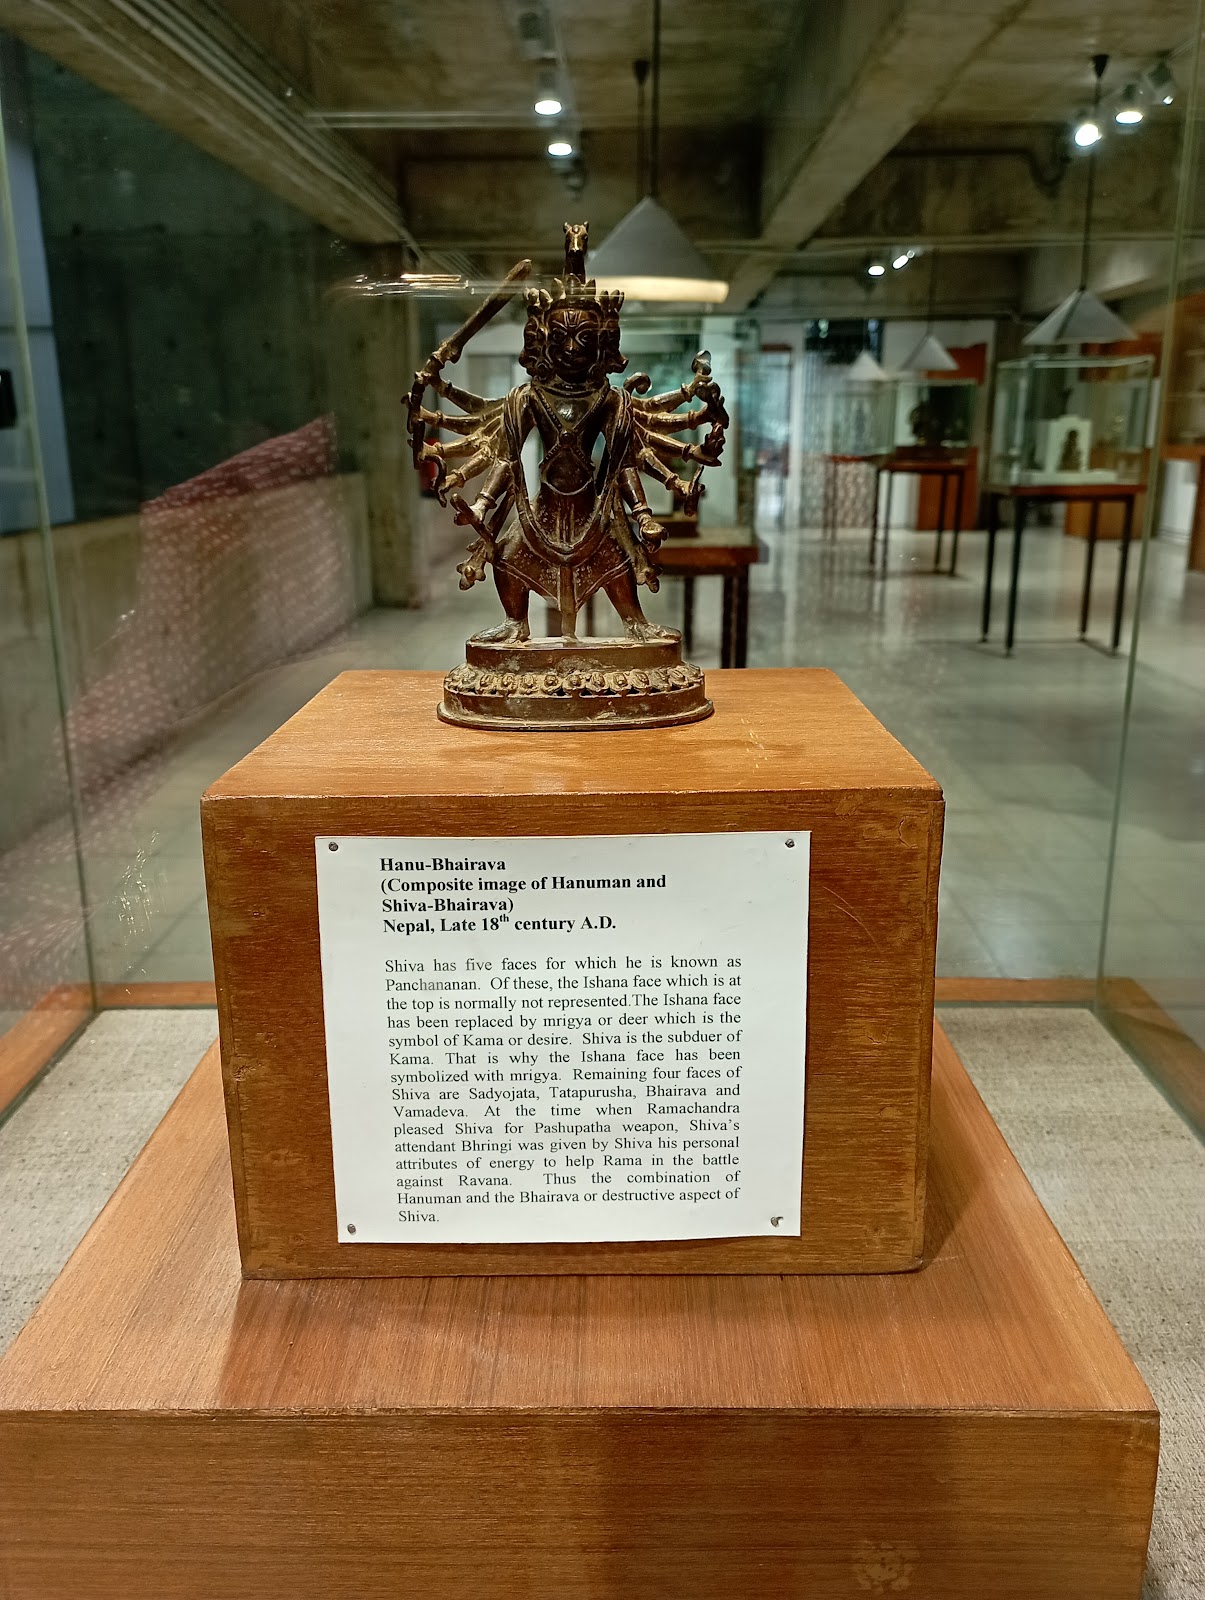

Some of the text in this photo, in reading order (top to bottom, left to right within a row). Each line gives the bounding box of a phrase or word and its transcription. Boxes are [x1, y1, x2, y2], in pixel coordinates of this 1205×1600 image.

[379, 857, 506, 872] Hanu-Bhairava
[380, 874, 667, 896] (Composite image of Hanuman and
[382, 897, 514, 914] Shiva-Bhairava)
[383, 918, 435, 936] Nepal,
[440, 918, 477, 932] Late
[514, 917, 576, 933] century
[580, 915, 617, 930] A.D.
[385, 954, 742, 973] Shiva has five faces for which he is known as
[385, 973, 742, 992] Panchananan. Of these, the Ishana face which is at
[386, 997, 408, 1010] the
[411, 999, 434, 1013] top
[438, 996, 450, 1010] is
[454, 995, 517, 1012] normally
[521, 997, 544, 1009] not
[663, 992, 709, 1006] Ishana
[712, 992, 742, 1005] face
[387, 1010, 741, 1031] has been replaced by mrigya or deer which is the
[388, 1029, 744, 1050] symbol of Kama or desire. Shiva is the subduer of
[389, 1047, 741, 1067] Kama. That is why the Ishana face has been
[390, 1065, 743, 1086] symbolized with mrigya. Remaining four faces of
[391, 1083, 741, 1102] Shiva are Sadyojata, Tatapurusha, Bhairava and
[393, 1101, 740, 1118] Vamadeva. At the time when Ramachandra
[393, 1122, 445, 1138] pleased
[455, 1122, 494, 1135] Shiva
[504, 1121, 524, 1134] for
[534, 1120, 612, 1136] Pashupatha
[621, 1123, 679, 1135] weapon,
[394, 1135, 739, 1154] attendant Bhringi was given by Shiva his personal
[395, 1153, 740, 1171] attributes of energy to help Rama in the battle
[396, 1169, 742, 1190] against Ravana. Thus the combination of
[397, 1186, 741, 1205] Hanuman and the Bhairava or destructive aspect of
[398, 1210, 440, 1223] Shiva.
